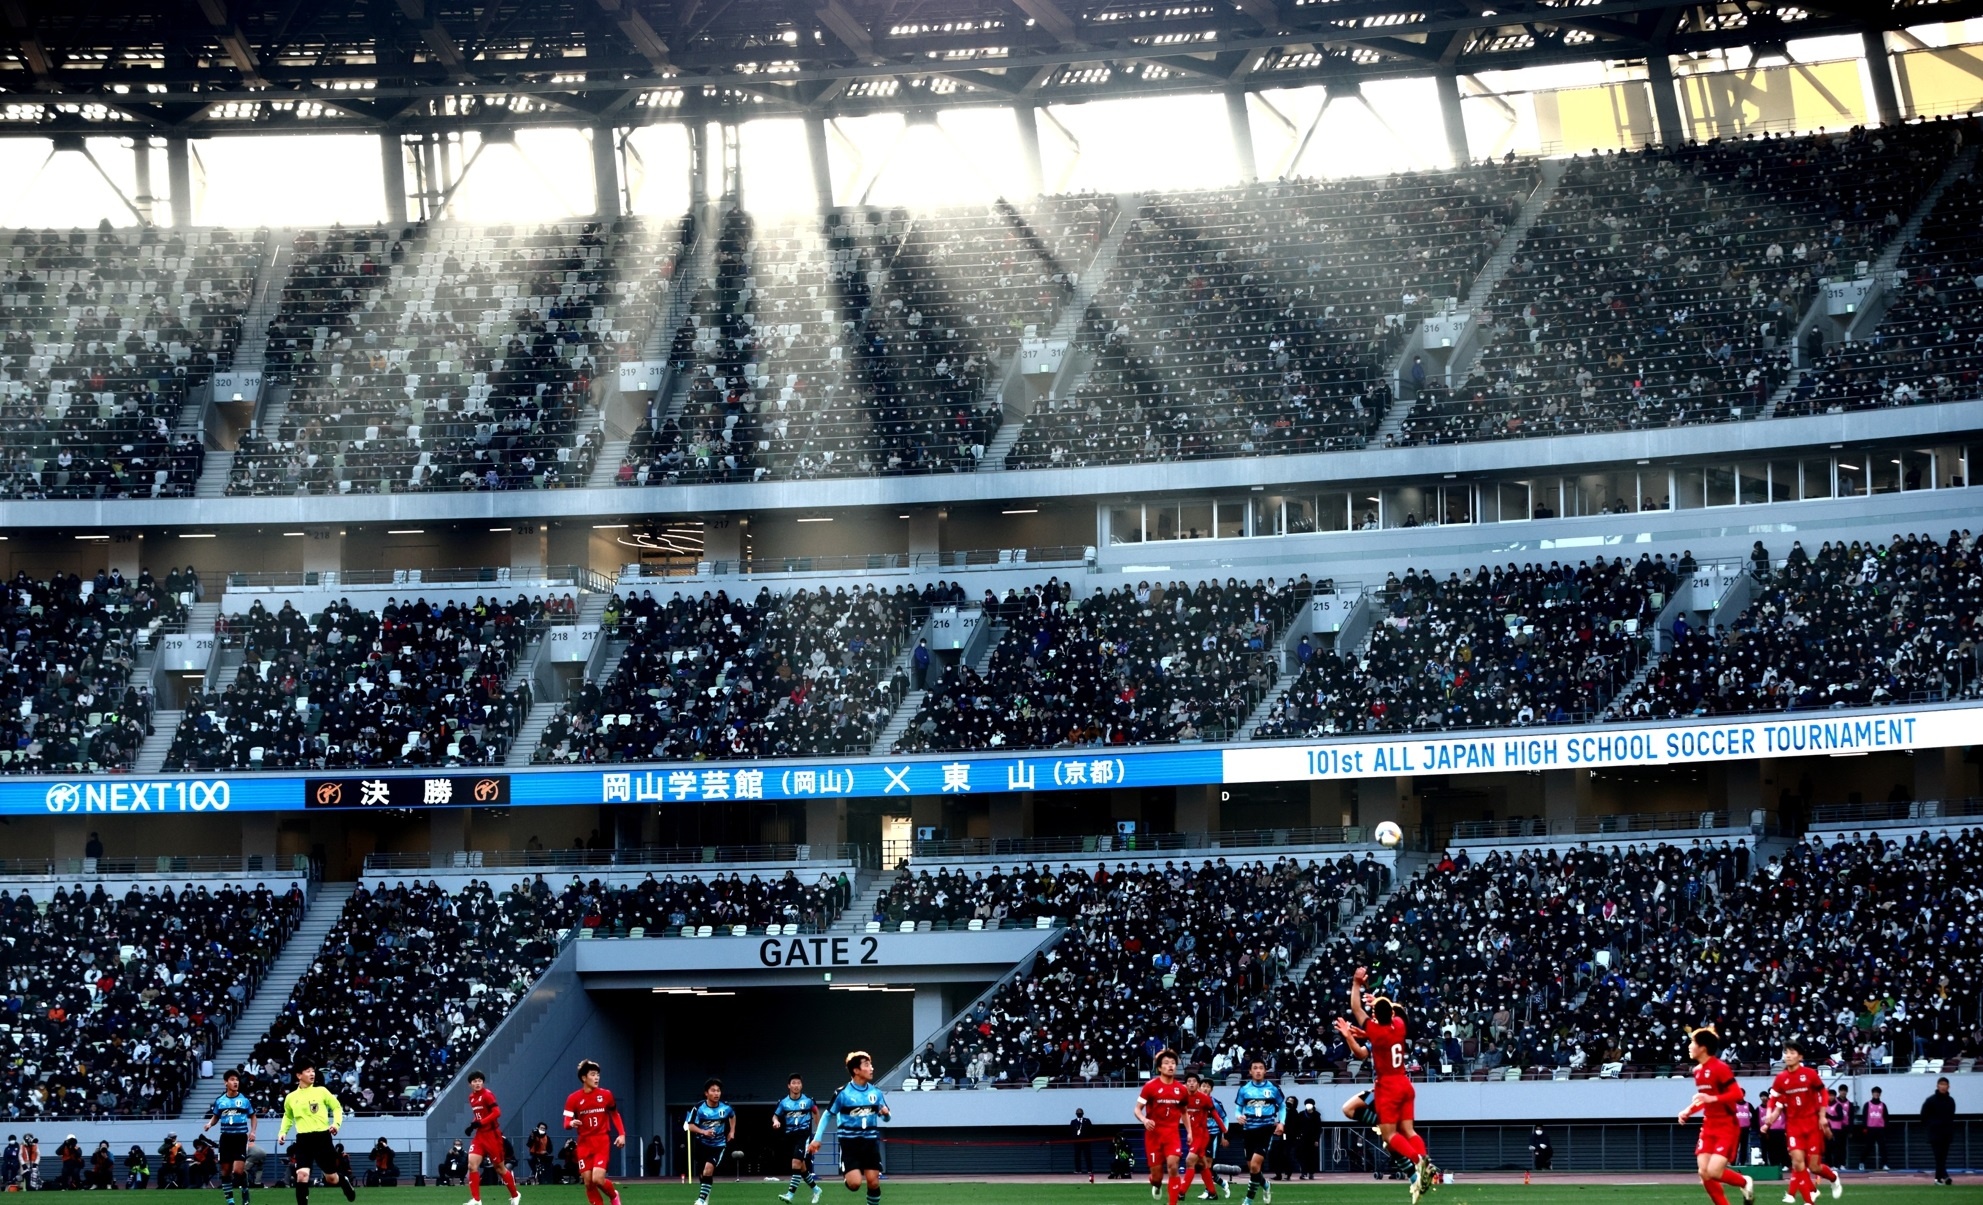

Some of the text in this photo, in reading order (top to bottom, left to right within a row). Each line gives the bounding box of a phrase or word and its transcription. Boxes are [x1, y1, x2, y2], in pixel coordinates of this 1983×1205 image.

[1827, 290, 1844, 298] 315
[1423, 325, 1440, 333] 316
[1022, 350, 1038, 359] 317
[620, 368, 636, 377] 319
[649, 368, 665, 376] 318
[215, 378, 232, 387] 320
[244, 378, 260, 387] 319
[713, 520, 729, 529] 217
[518, 526, 533, 535] 218
[314, 531, 330, 540] 218
[1693, 579, 1710, 588] 214
[1313, 602, 1330, 611] 215
[933, 620, 950, 629] 216
[551, 633, 568, 641] 218
[582, 631, 598, 641] 217
[166, 641, 183, 650] 219
[196, 640, 213, 649] 218
[1307, 717, 1916, 775] 101st ALL JAPAN HIGH SCHOOL SOCCER TOURNAMENT
[602, 769, 765, 803] 岡山学芸館
[86, 780, 231, 812] NEXT100
[1221, 791, 1230, 802] D
[759, 936, 879, 968] GATE 2
[1391, 1043, 1403, 1068] 6
[588, 1116, 599, 1127] 13
